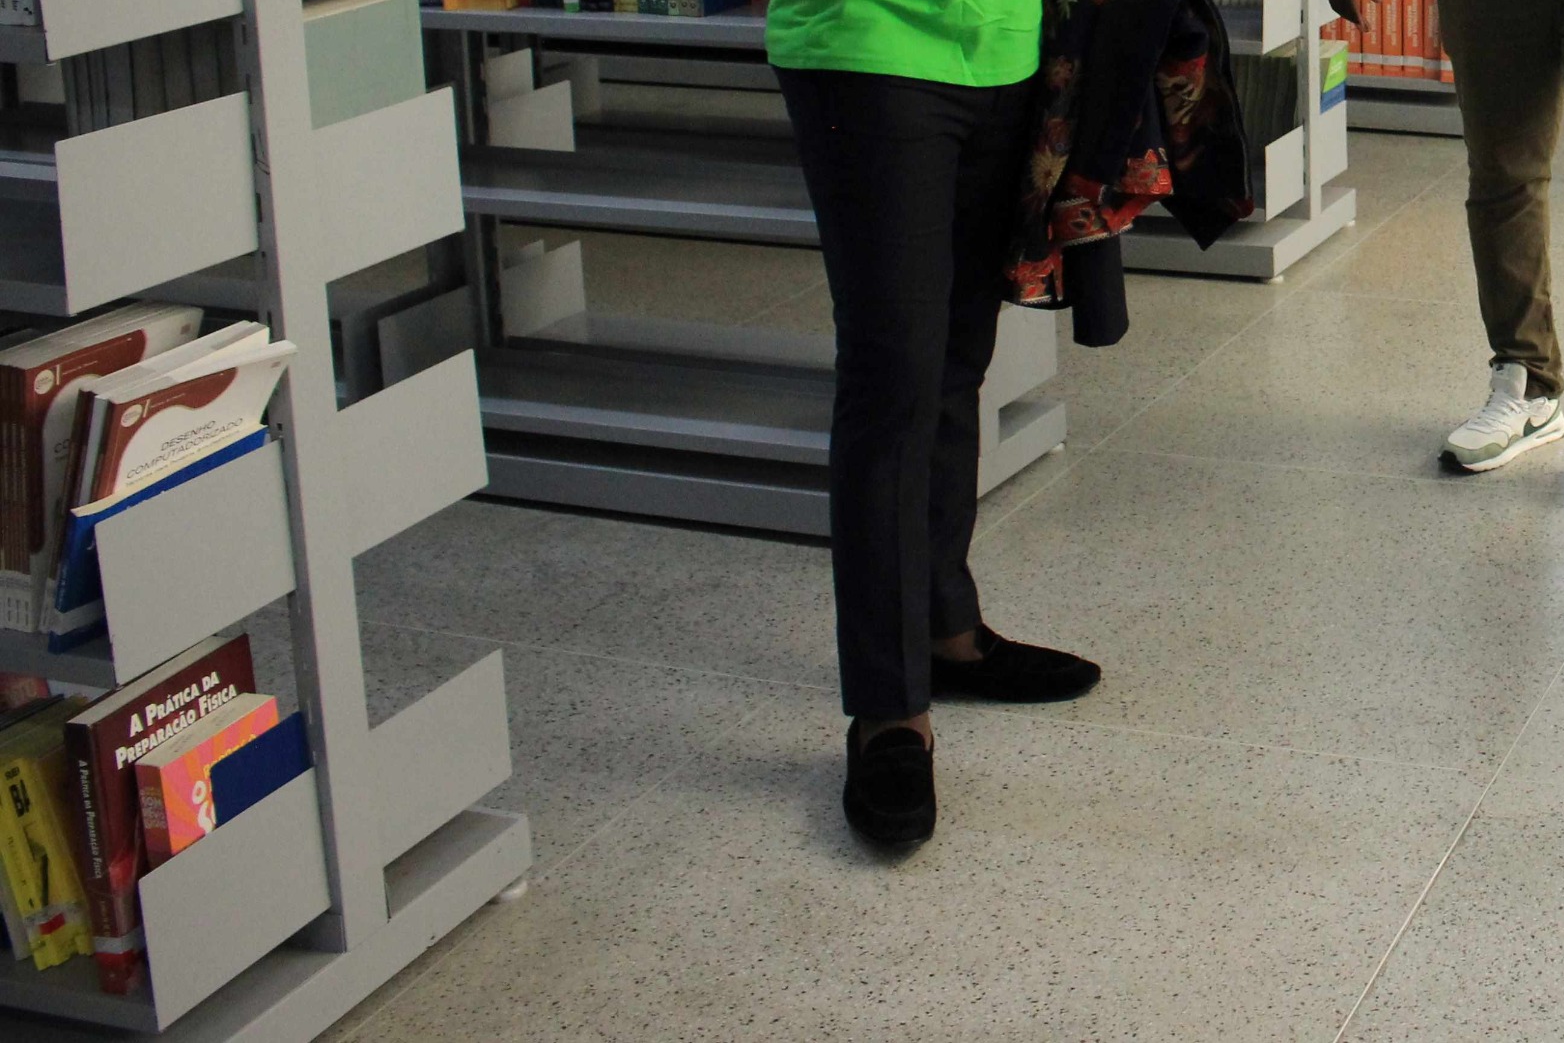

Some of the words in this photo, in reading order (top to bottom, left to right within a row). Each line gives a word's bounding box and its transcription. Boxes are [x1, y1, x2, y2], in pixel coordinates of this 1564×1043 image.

[126, 418, 243, 479] COMPUTADORIZADO
[161, 420, 216, 451] DESENHO
[130, 713, 143, 738] A
[202, 671, 220, 692] DA
